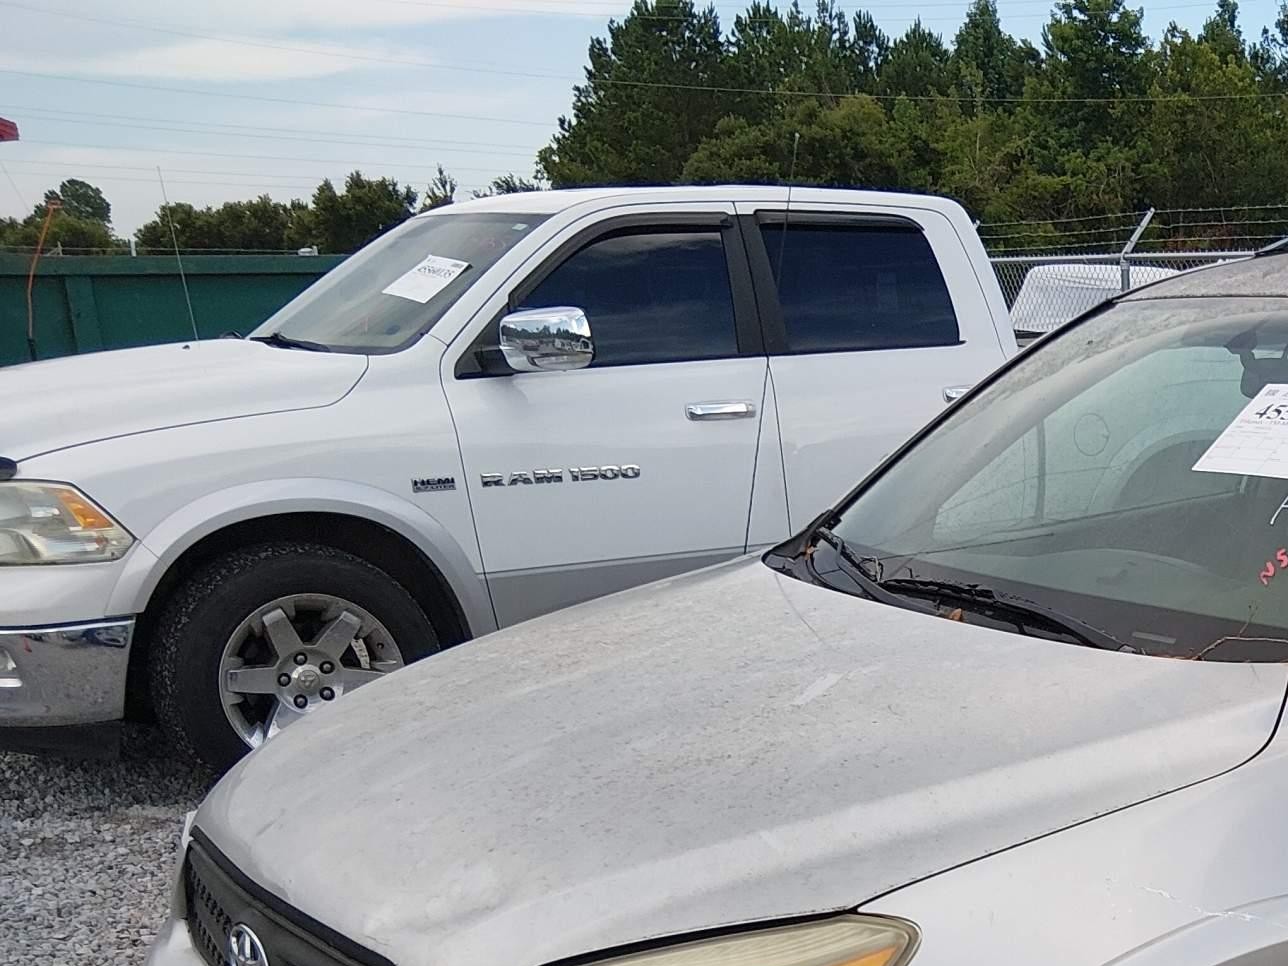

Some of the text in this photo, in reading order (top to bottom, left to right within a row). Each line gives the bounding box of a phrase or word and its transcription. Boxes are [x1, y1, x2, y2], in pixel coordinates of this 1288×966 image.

[413, 477, 455, 487] HEMI
[480, 464, 641, 488] RAM 1500
